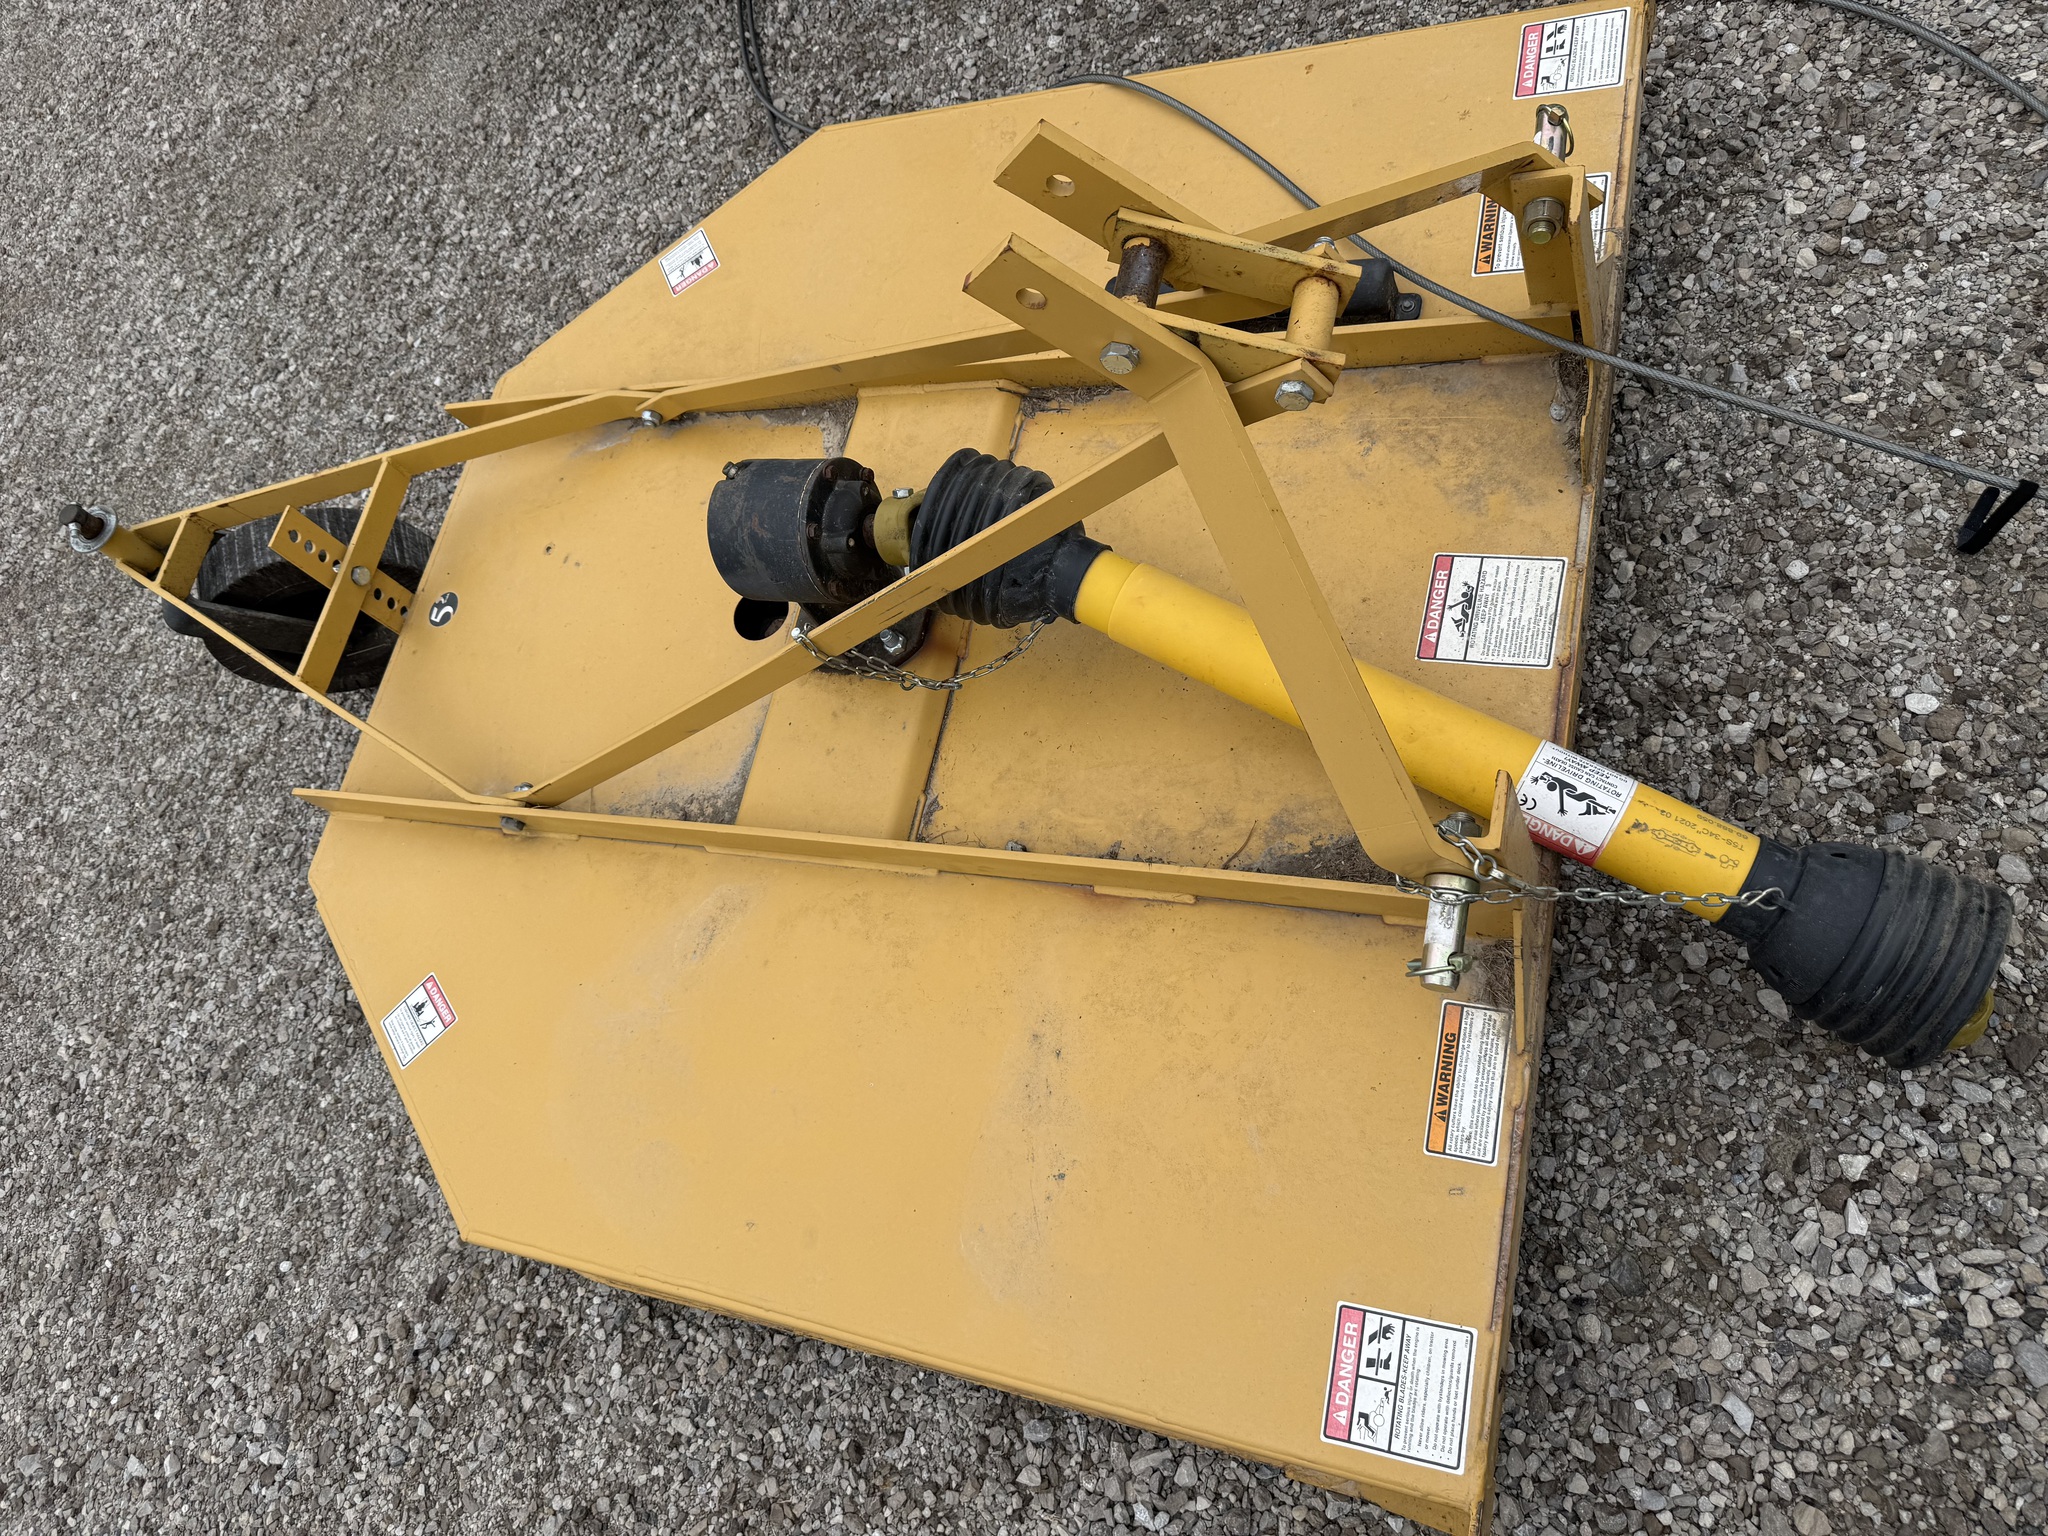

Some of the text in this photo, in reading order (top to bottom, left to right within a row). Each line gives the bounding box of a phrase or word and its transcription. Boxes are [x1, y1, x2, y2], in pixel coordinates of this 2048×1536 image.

[1523, 31, 1538, 78] DANGER
[1480, 199, 1498, 253] WARNIN
[1498, 224, 1506, 242] serious
[1495, 243, 1503, 262] prevent
[1426, 569, 1448, 629] DANGER
[1468, 570, 1487, 648] ROTATING DRIVELINE HAZARD
[1479, 608, 1487, 623] KEEP
[1584, 770, 1595, 778] CAN
[1588, 767, 1610, 780] KEEP
[1584, 776, 1622, 798] ROTATING
[1672, 815, 1697, 831] 2021
[429, 986, 452, 1023] DANGER
[1466, 1017, 1474, 1043] bystanders
[1479, 1017, 1487, 1040] highways
[1436, 1031, 1456, 1107] WARNING
[1481, 1084, 1489, 1109] permanent
[1483, 1115, 1491, 1139] approved
[1335, 1320, 1358, 1406] DANGER
[1398, 1354, 1409, 1403] BLADES-KEEP
[1440, 1444, 1445, 1452] Do
[1445, 1361, 1454, 1404] deflectors/guards
[1394, 1404, 1403, 1439] ROTATING
[1432, 1442, 1437, 1450] Do
[1447, 1446, 1452, 1454] Do
